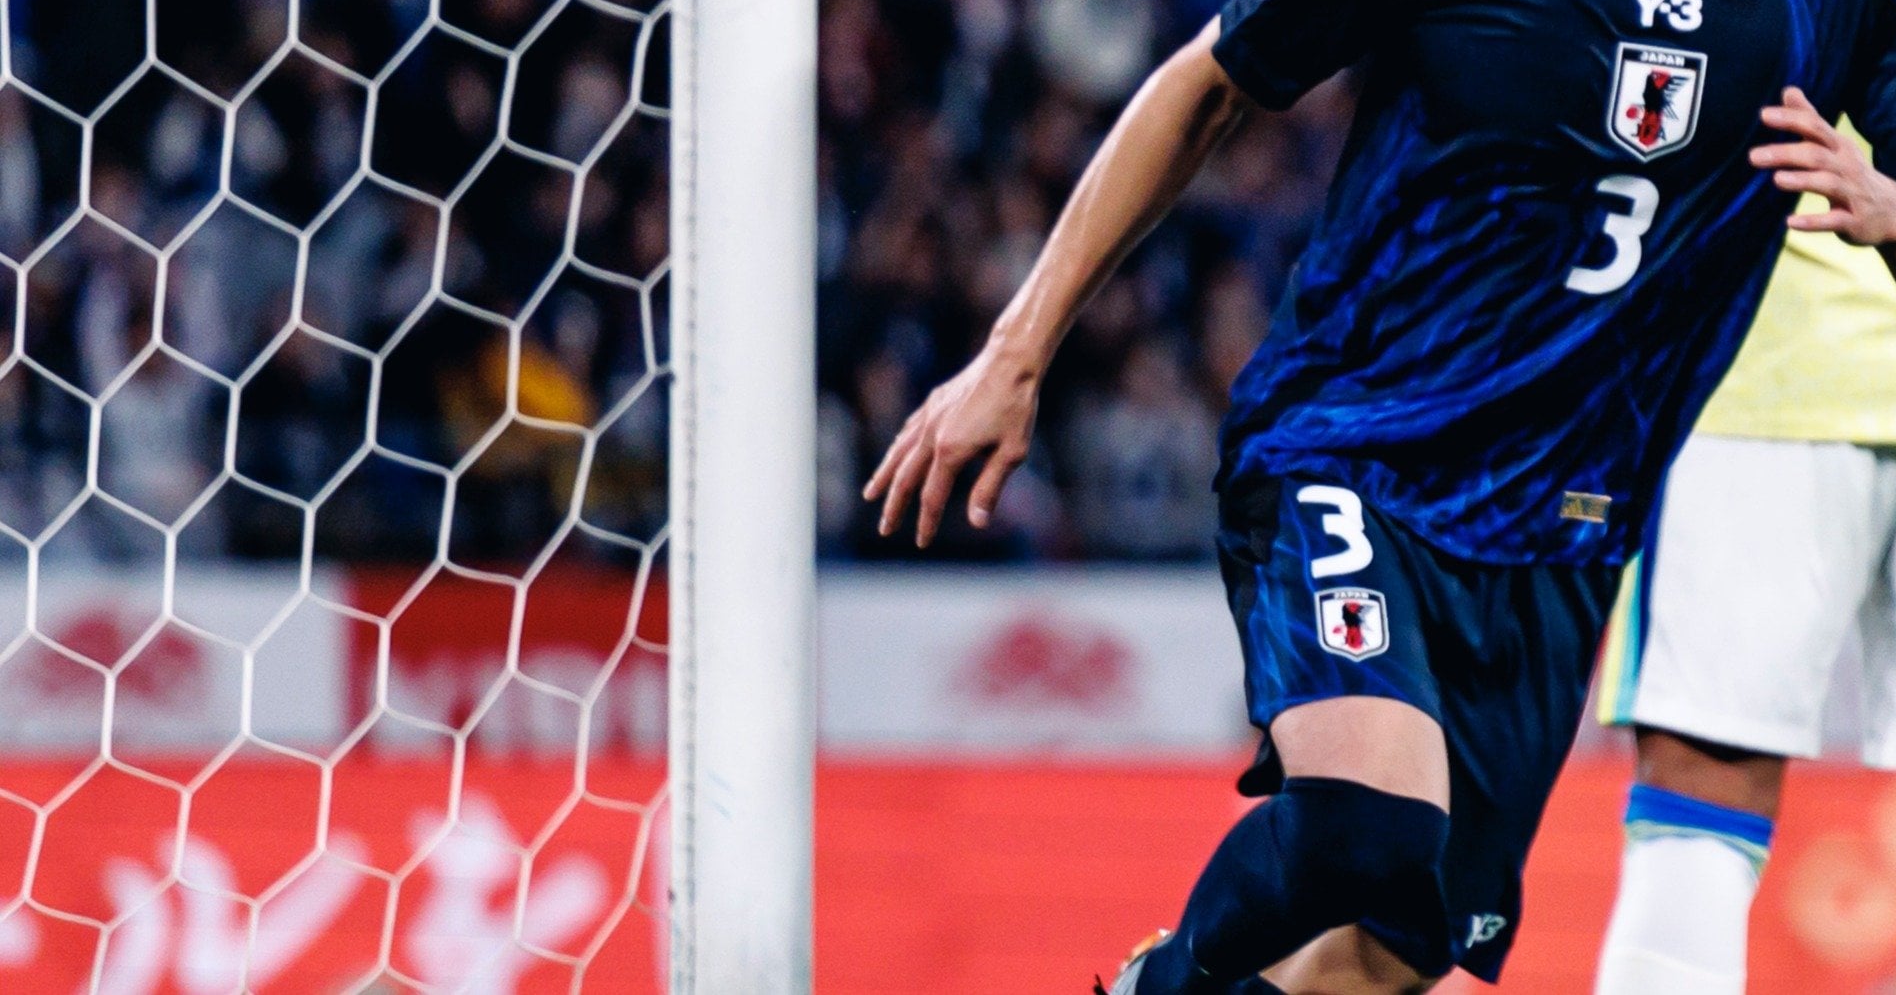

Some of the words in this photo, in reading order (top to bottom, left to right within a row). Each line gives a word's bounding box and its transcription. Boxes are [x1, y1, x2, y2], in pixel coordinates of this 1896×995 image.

[1640, 51, 1685, 67] JAPAN
[1565, 175, 1660, 295] 3
[1296, 484, 1373, 579] 3
